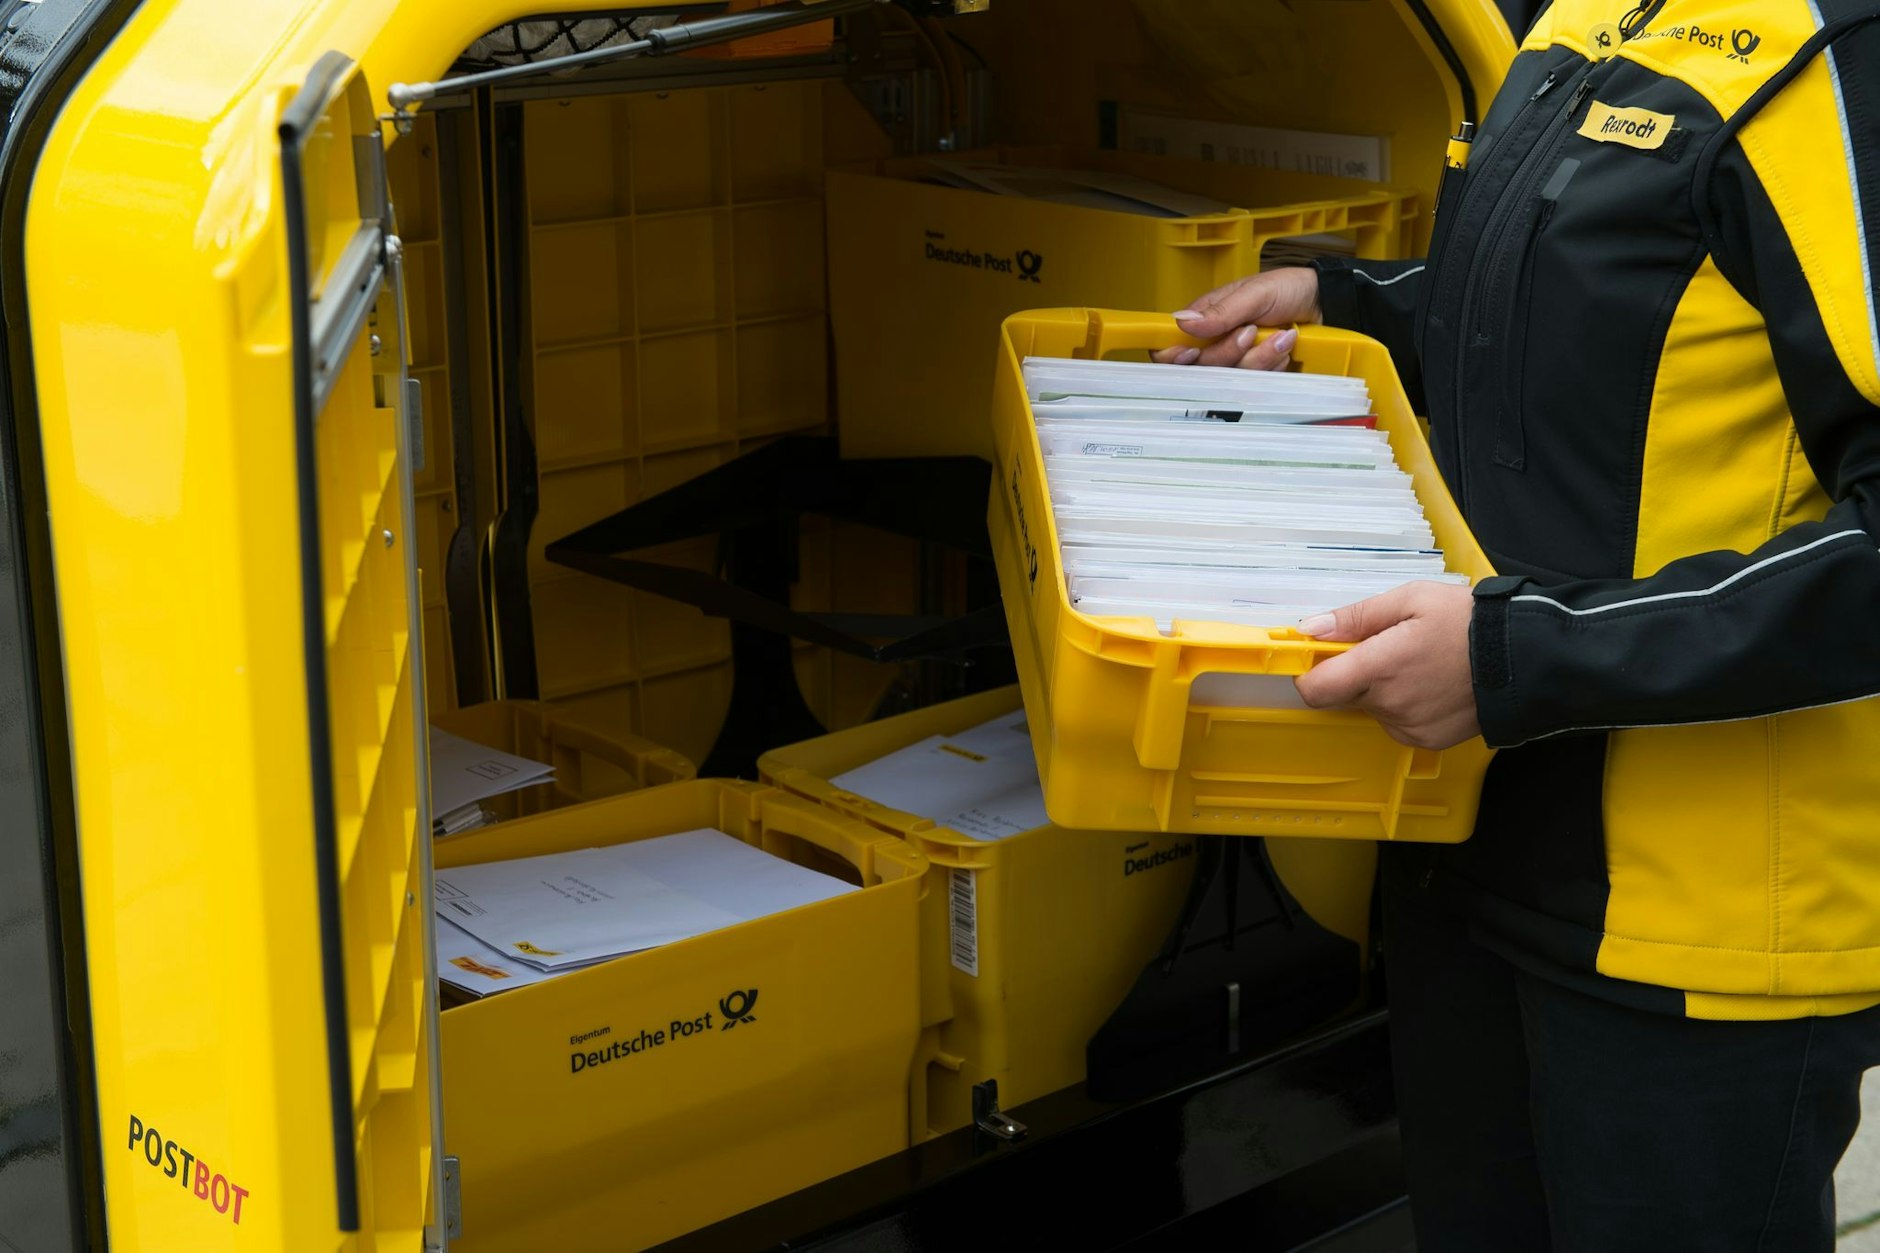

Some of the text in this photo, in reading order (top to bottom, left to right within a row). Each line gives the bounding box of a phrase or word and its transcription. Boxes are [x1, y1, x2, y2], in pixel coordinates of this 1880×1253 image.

[1689, 25, 1725, 51] Post
[1601, 114, 1657, 139] Rexrodt
[925, 242, 1013, 274] Deutsche Post
[1124, 842, 1192, 876] Deutsche
[570, 1026, 611, 1045] Eigentum
[570, 1011, 713, 1074] Deutsche Post
[128, 1114, 249, 1225] POSTBOT
